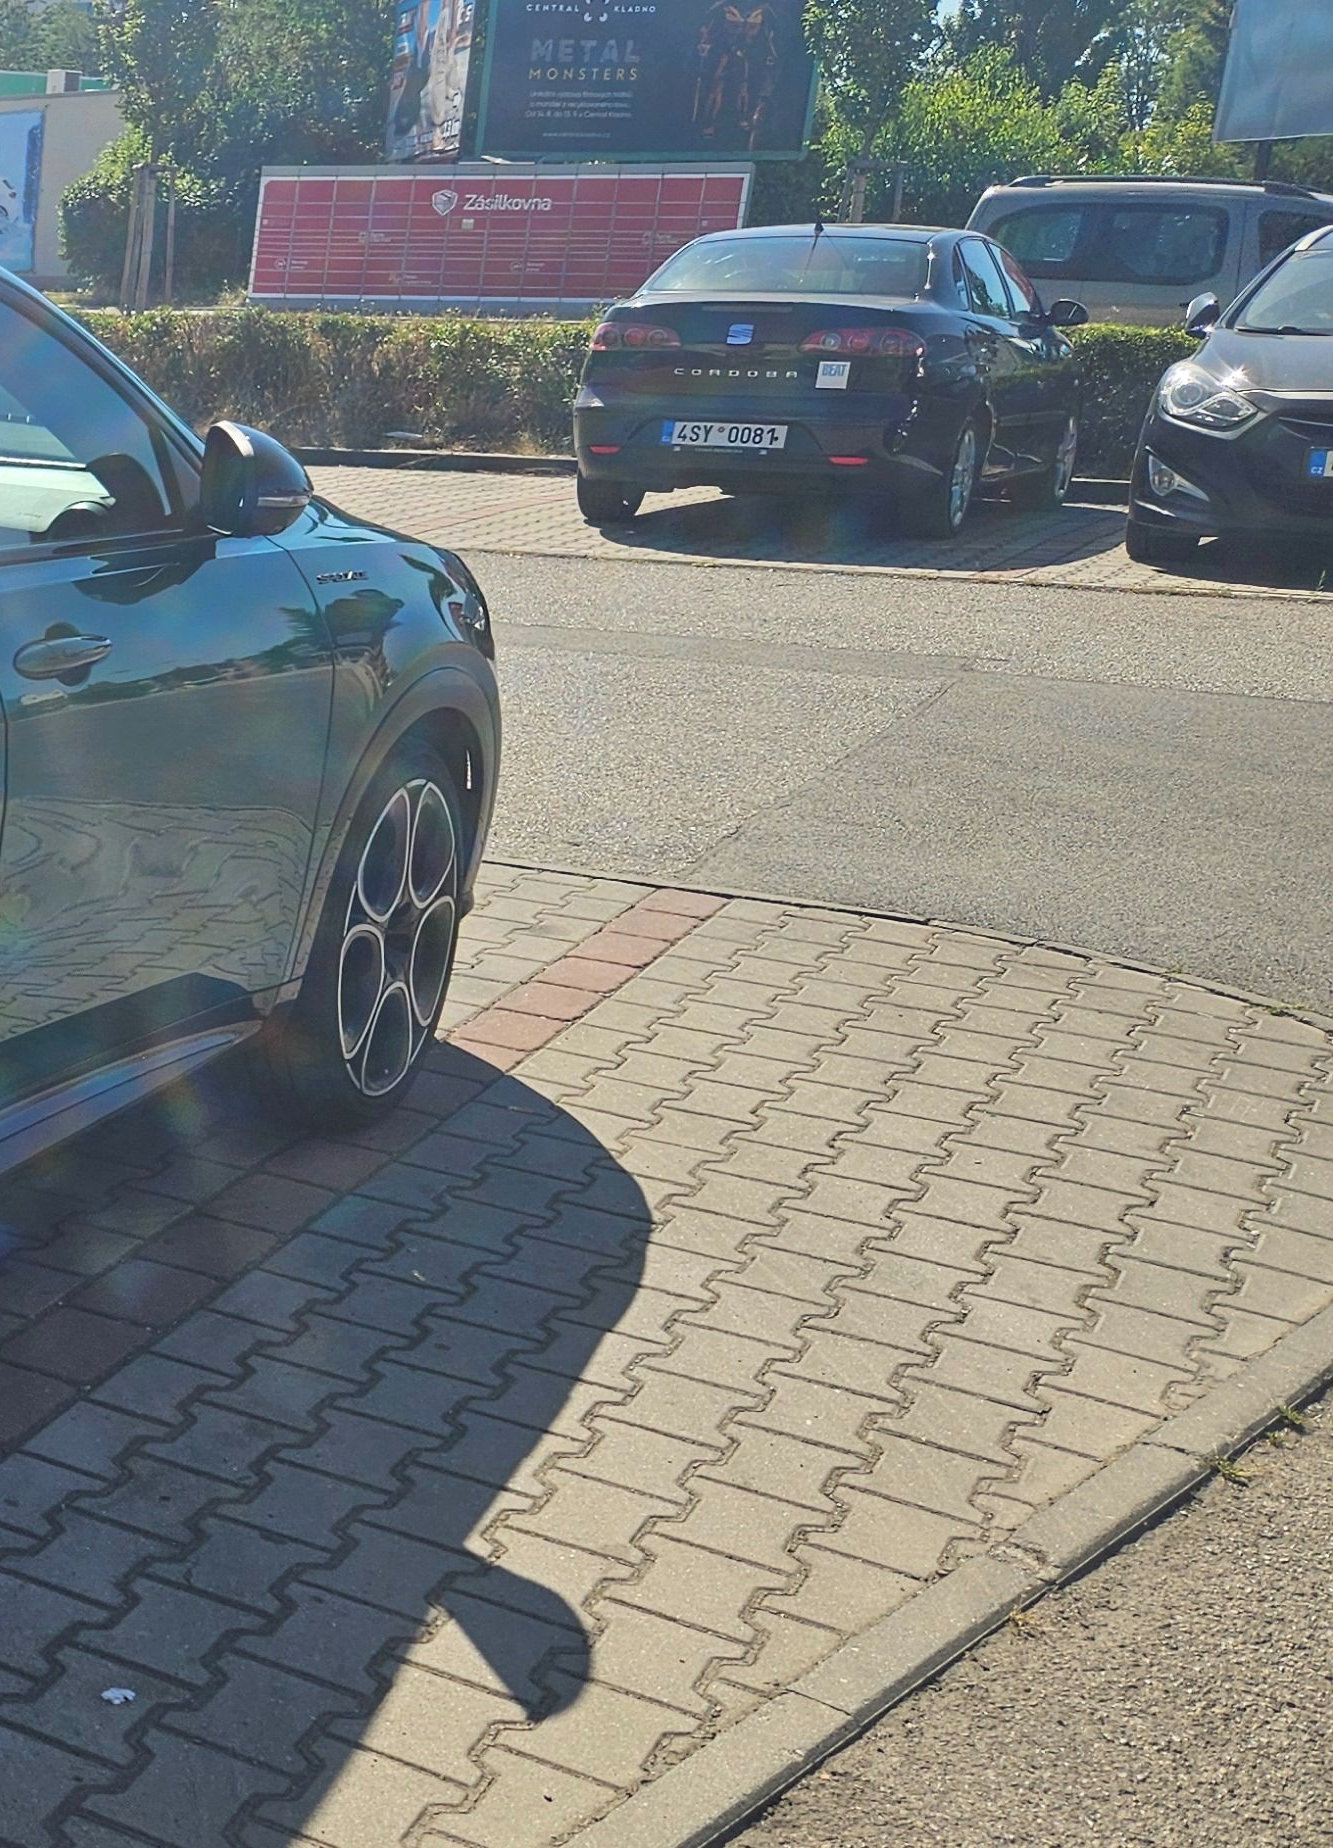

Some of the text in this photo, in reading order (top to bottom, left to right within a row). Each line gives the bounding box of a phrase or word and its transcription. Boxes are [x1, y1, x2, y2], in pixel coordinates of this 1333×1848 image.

[526, 4, 656, 13] CENTRAL KLADNO
[530, 39, 640, 62] METAL
[528, 67, 638, 80] MONSTERS
[463, 194, 552, 211] Zásilkovna
[674, 367, 798, 378] CORDOBA
[677, 424, 714, 443] 4SY
[727, 426, 777, 446] 0081
[1311, 466, 1323, 474] CZ
